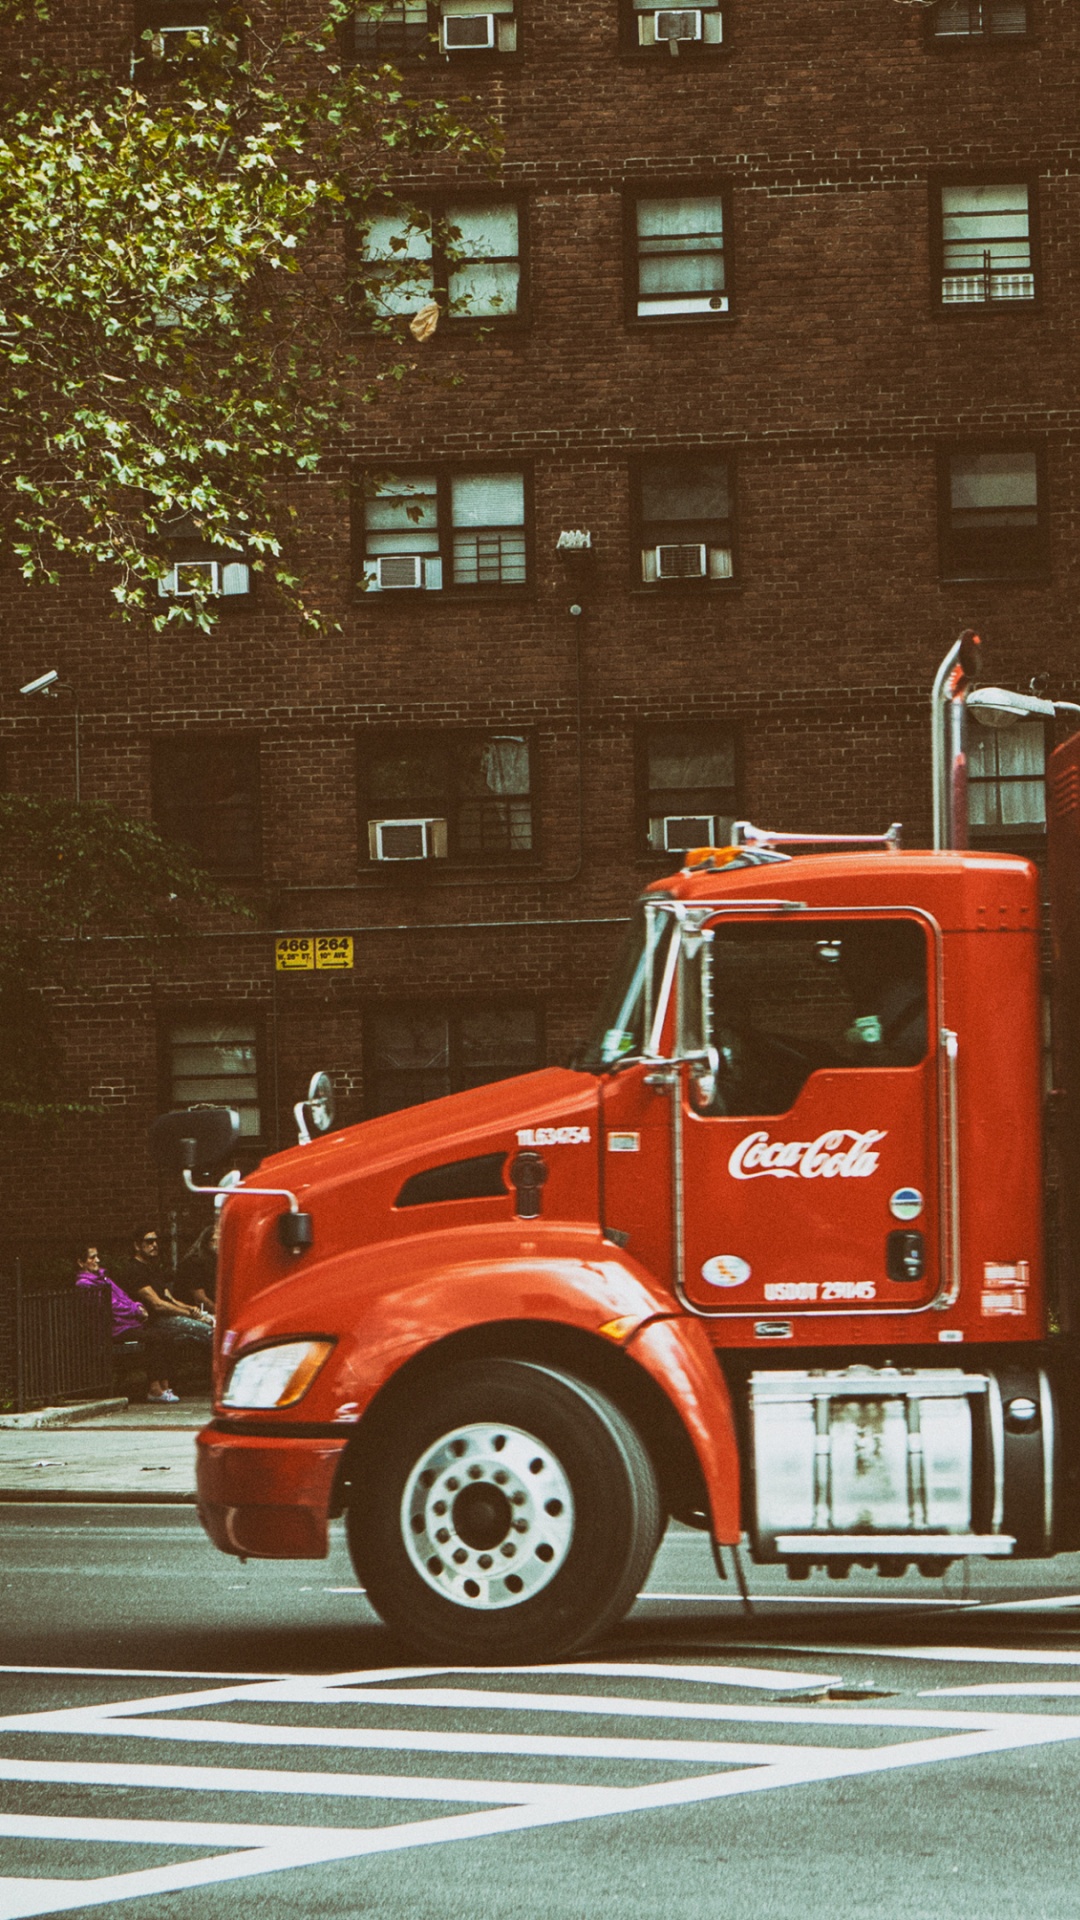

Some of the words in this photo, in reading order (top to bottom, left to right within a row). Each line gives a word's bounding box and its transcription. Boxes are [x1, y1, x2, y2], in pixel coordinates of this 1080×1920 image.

[278, 939, 309, 952] 466
[318, 938, 349, 951] 264
[728, 1129, 888, 1180] Coca-Cola
[763, 1282, 819, 1301] USDOT
